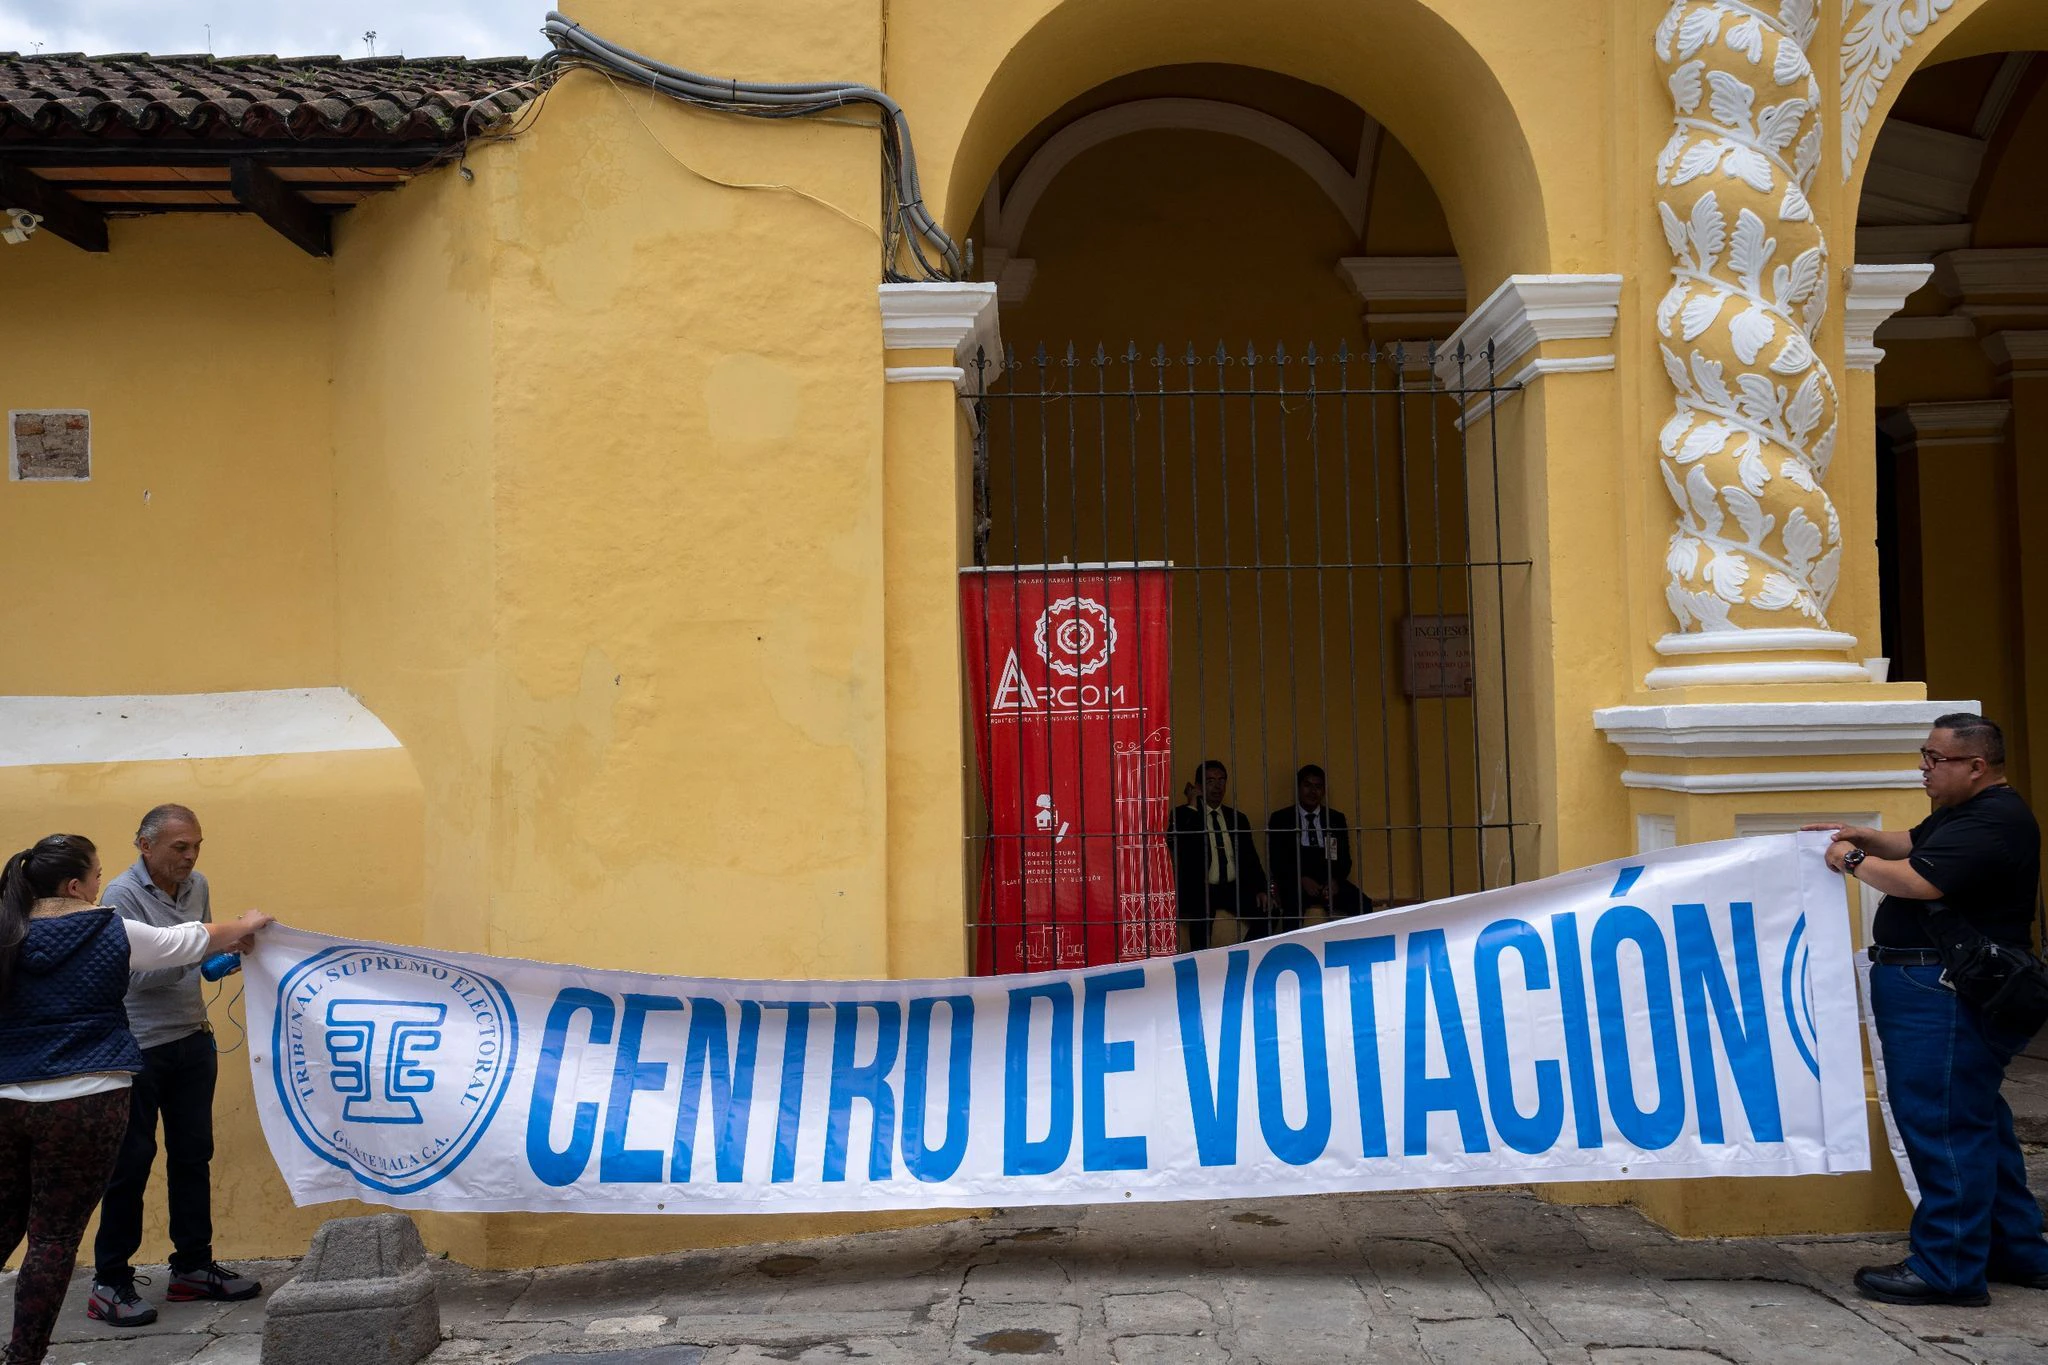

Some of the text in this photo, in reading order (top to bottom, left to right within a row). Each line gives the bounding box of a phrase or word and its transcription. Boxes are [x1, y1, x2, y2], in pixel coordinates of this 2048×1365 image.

[992, 646, 1125, 710] ARCOM
[1043, 714, 1092, 723] CNSERVACÓN
[291, 956, 496, 1107] TRIBUNAL SUPREMO ELECTORAL
[526, 865, 1784, 1187] CENTRO DE VOTACIÓN
[421, 1137, 450, 1160] C.A.
